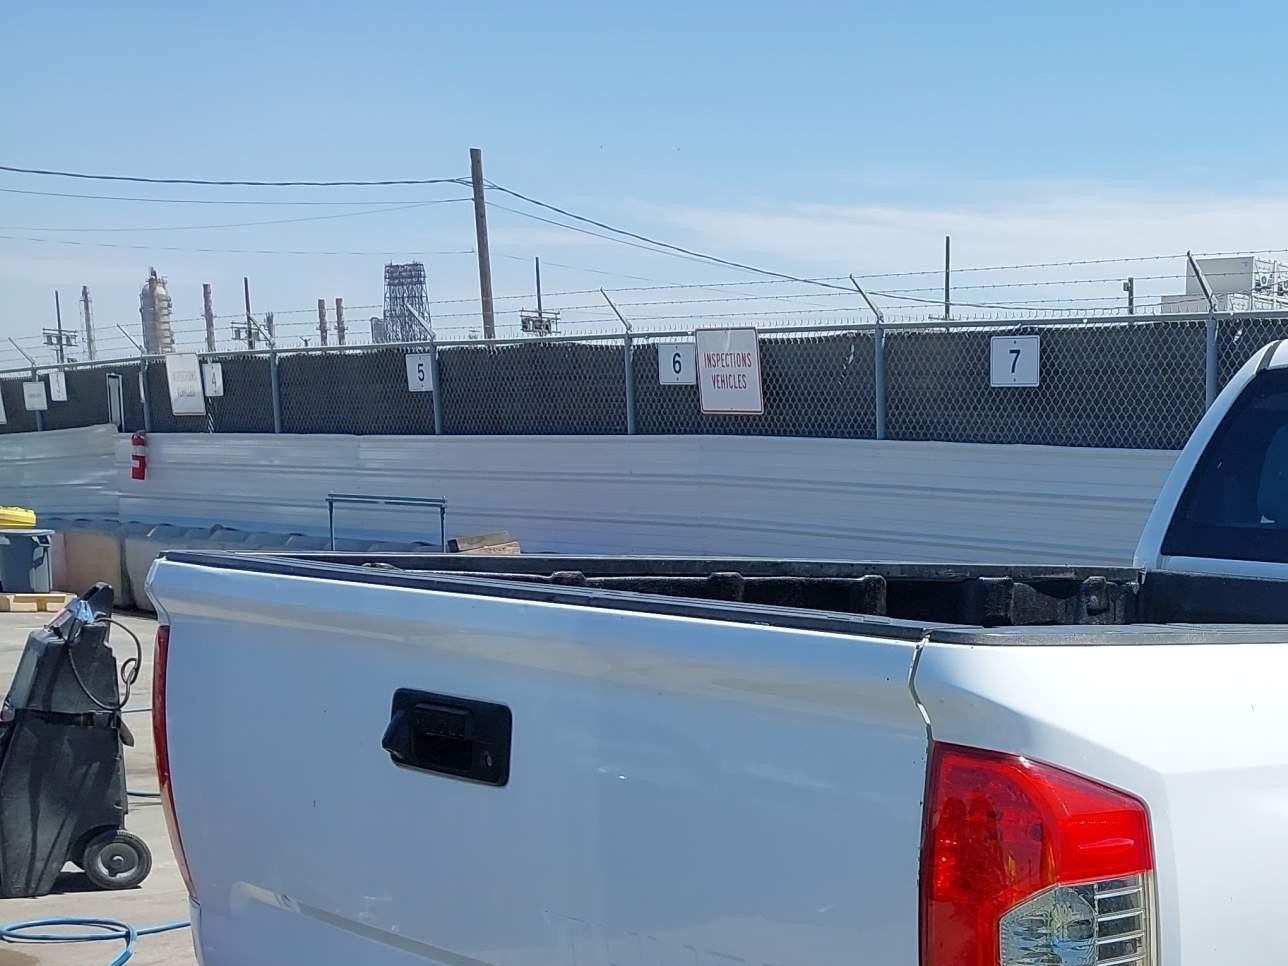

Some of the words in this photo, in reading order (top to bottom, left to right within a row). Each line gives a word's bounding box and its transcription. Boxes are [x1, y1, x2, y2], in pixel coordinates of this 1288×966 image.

[672, 353, 682, 374] 6
[703, 352, 752, 369] INSPECTIONS
[1009, 349, 1021, 374] 7
[417, 363, 425, 382] 5
[711, 374, 747, 390] VEHICLES
